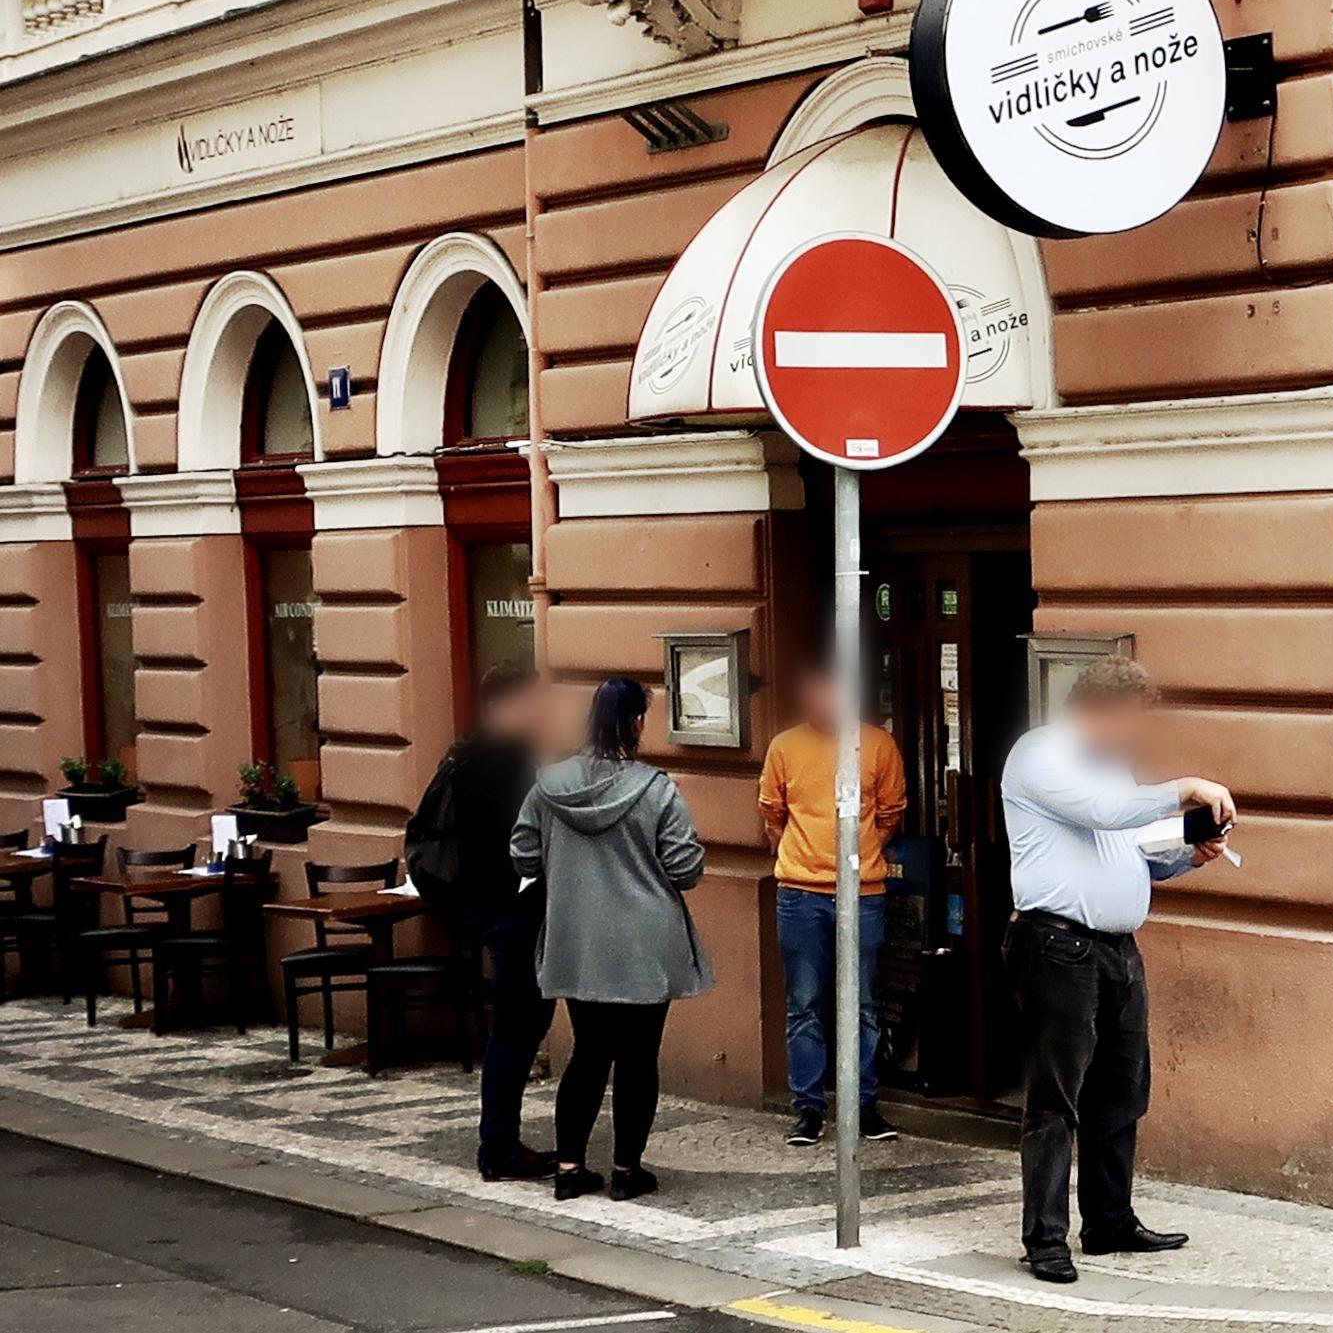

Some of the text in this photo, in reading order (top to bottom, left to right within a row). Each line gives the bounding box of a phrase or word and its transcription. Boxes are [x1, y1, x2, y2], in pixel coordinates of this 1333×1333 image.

[988, 33, 1199, 124] vidličky a nože
